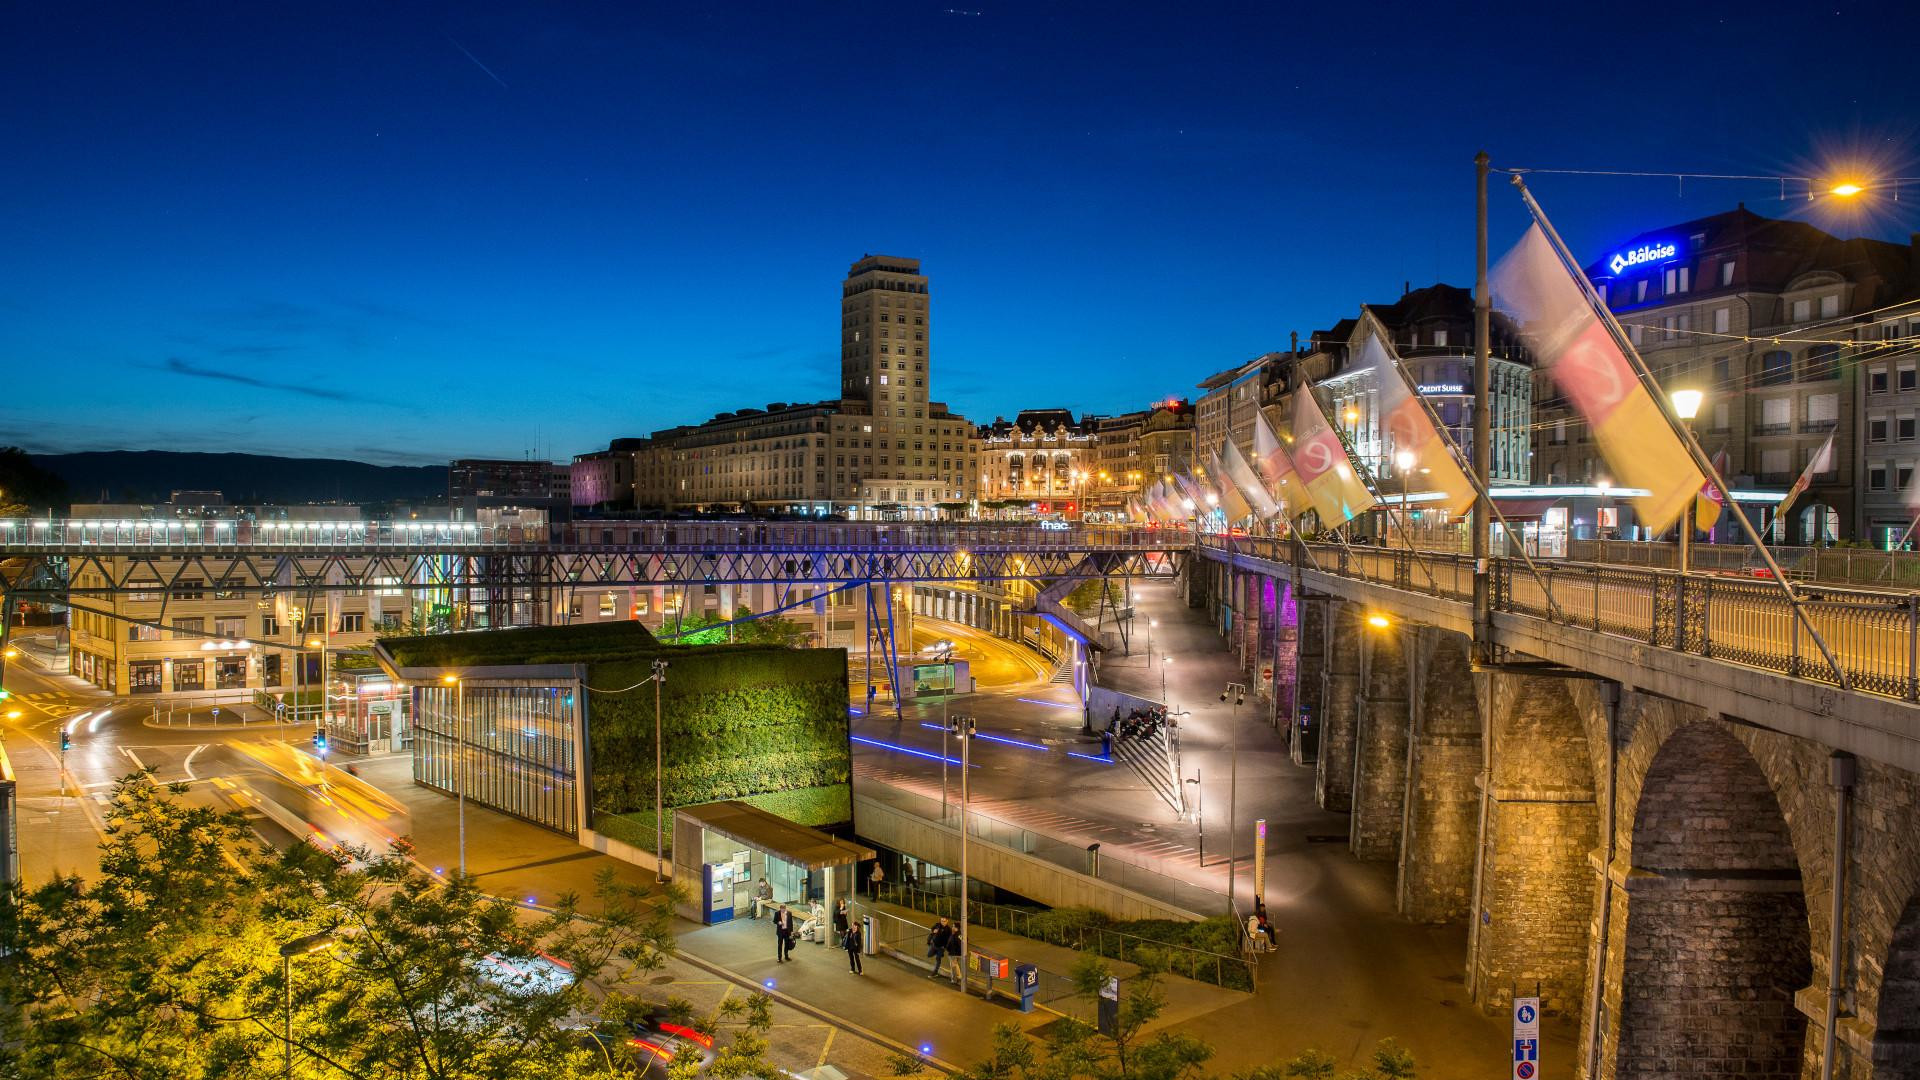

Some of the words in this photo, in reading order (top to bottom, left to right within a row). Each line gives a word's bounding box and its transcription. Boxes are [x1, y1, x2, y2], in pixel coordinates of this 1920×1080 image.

[1628, 243, 1675, 265] Bâloise
[1441, 384, 1463, 392] SUISSE
[1041, 520, 1069, 530] fnac
